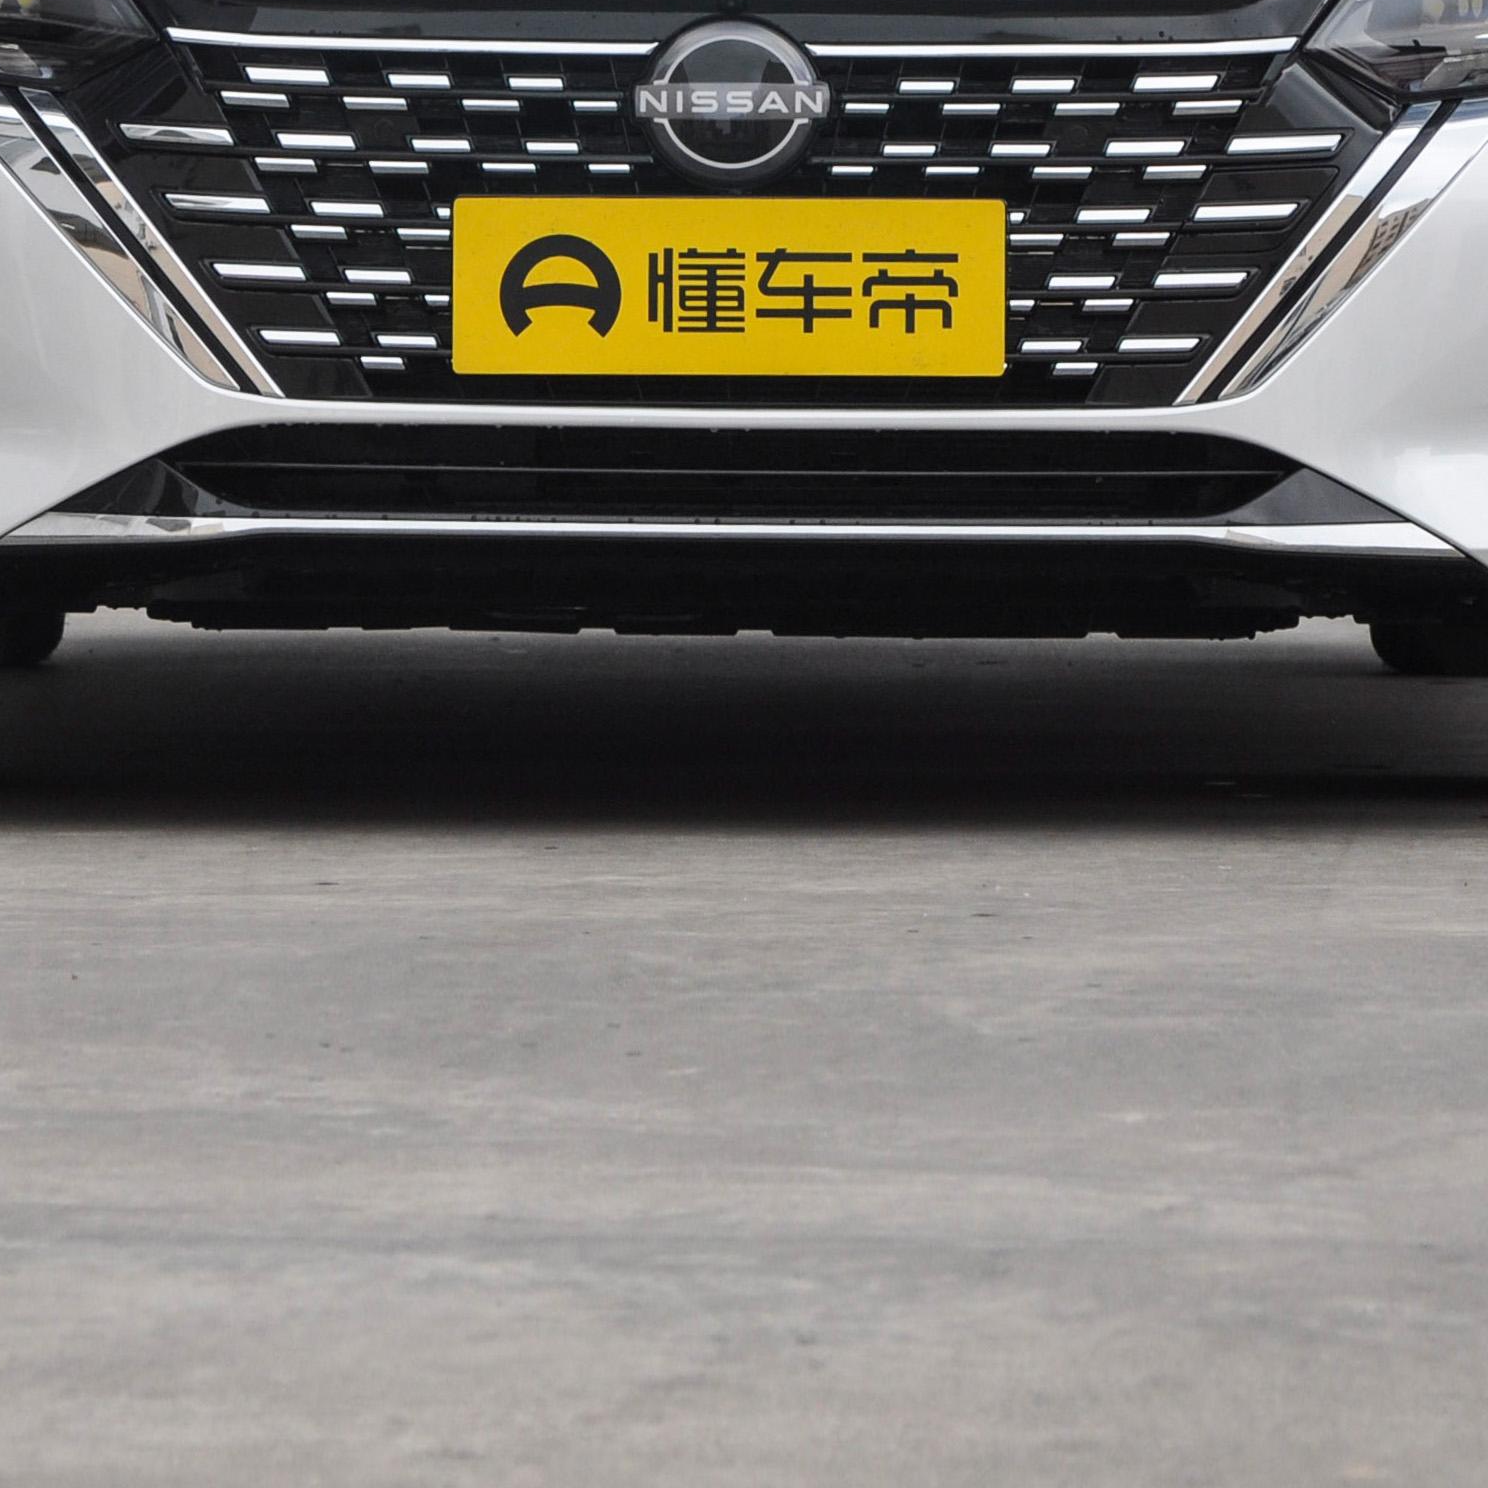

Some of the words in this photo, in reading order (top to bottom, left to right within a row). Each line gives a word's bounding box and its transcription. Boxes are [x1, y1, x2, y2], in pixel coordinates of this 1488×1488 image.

[639, 90, 823, 114] NISSAN
[648, 248, 959, 334] 懂车帝
